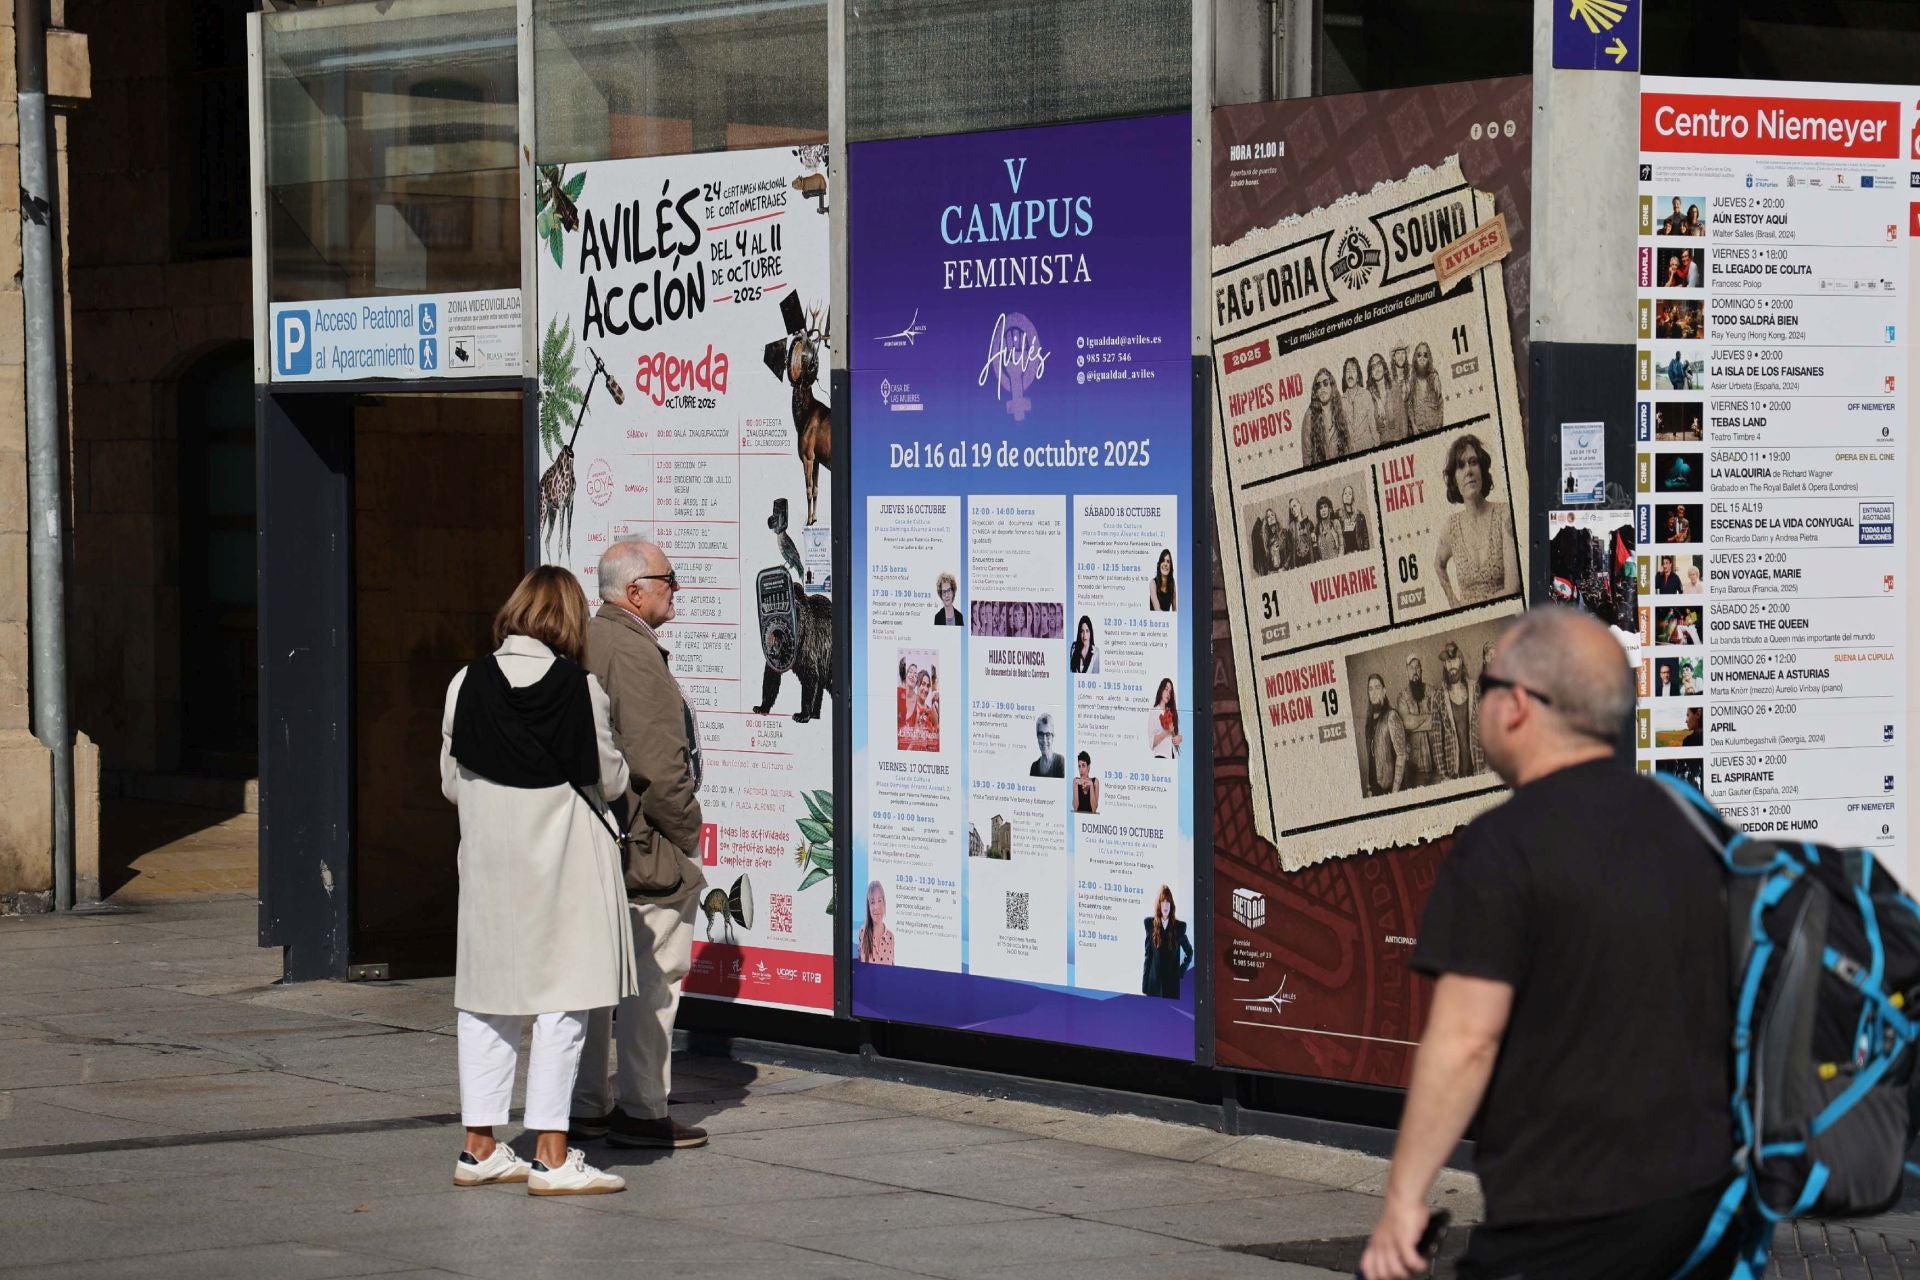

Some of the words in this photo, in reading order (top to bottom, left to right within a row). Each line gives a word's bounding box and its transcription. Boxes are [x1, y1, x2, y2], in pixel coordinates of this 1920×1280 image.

[1655, 106, 1748, 138] Centro
[1757, 109, 1887, 147] Niemeyer
[1231, 145, 1251, 160] HORA
[1255, 142, 1276, 159] 21.00
[1279, 141, 1284, 156] H
[1004, 158, 1027, 193] V
[704, 181, 721, 201] 24
[723, 184, 756, 198] CERTAMEN
[758, 177, 786, 194] NACIONAL
[706, 206, 715, 219] DE
[719, 191, 787, 217] CORTOMETRAJES
[1713, 197, 1747, 208] JUEVES
[1749, 198, 1754, 208] 2
[1763, 199, 1784, 208] 20:00
[580, 179, 700, 274] AVILÉS
[941, 196, 1093, 244] CAMPUS
[1713, 212, 1732, 224] AÚN
[1734, 214, 1764, 224] ESTOY
[1766, 212, 1788, 225] AQUÍ
[711, 239, 732, 261] DEL
[736, 230, 746, 257] 4
[752, 236, 767, 254] AL
[1445, 230, 1499, 270] AVILÉS
[712, 270, 724, 286] DE
[727, 256, 782, 282] OCTUBRE
[944, 254, 1091, 289] FEMINISTA
[1216, 256, 1318, 326] FACTORIA
[1392, 201, 1466, 263] SOUND
[1712, 265, 1723, 274] EL
[1726, 265, 1762, 274] LEGADO
[1766, 265, 1777, 274] DE
[1780, 265, 1812, 275] COLITA
[583, 254, 705, 340] ACCIÓN
[734, 287, 762, 303] 2025
[448, 299, 467, 313] ZONA
[469, 297, 520, 311] VIDEOVIGILADA
[315, 309, 357, 332] Acceso
[363, 304, 413, 329] Peatonal
[1290, 336, 1298, 346] La
[1300, 328, 1325, 343] música
[1337, 319, 1352, 329] vivo
[1354, 313, 1363, 324] de
[1365, 311, 1371, 320] la
[1373, 299, 1403, 317] Factoría
[1405, 288, 1436, 306] Cultural
[1712, 315, 1737, 325] TODO
[1740, 313, 1775, 325] SALDRÁ
[1777, 316, 1798, 325] BIEN
[285, 318, 305, 369] P
[1452, 325, 1469, 355] 11
[316, 347, 325, 369] al
[332, 343, 414, 373] Aparcamiento
[979, 313, 1050, 400] Avilés
[1086, 354, 1099, 363] 985
[1102, 354, 1116, 363] 527
[1118, 353, 1131, 362] 546
[1232, 349, 1261, 366] 2025
[636, 344, 728, 406] agenda
[1086, 369, 1154, 381] @igualdad_aviles
[1454, 360, 1476, 374] OCT
[1711, 367, 1722, 376] LA
[1725, 367, 1744, 376] ISLA
[1747, 367, 1758, 376] DE
[1762, 367, 1779, 376] LOS
[1782, 367, 1824, 376] FAISANES
[666, 396, 696, 409] OCTUBRE
[698, 398, 716, 408] 2025
[900, 394, 920, 402] MUJERES
[1229, 384, 1274, 417] HIPPIES
[1279, 373, 1303, 400] AND
[1711, 401, 1748, 411] VIERNES
[1751, 401, 1760, 411] 10
[1769, 401, 1791, 411] 20:00
[1233, 409, 1292, 448] COWBOYS
[1711, 418, 1740, 427] TEBAS
[1743, 417, 1766, 426] LAND
[890, 442, 920, 468] Del
[925, 444, 943, 467] 16
[948, 441, 966, 467] al
[972, 443, 991, 467] 19
[997, 441, 1019, 467] de
[1024, 440, 1098, 467] octubre
[1104, 439, 1150, 466] 2025
[1382, 454, 1415, 485] LILLY
[1711, 469, 1721, 478] LA
[1724, 468, 1771, 479] VALQUIRIA
[1385, 480, 1424, 512] HIATT
[880, 505, 904, 514] JUEVES
[906, 505, 914, 514] 16
[915, 505, 946, 514] OCTUBRE
[1085, 505, 1114, 516] SÁBADO
[1117, 508, 1124, 516] 18
[1127, 507, 1160, 517] OCTUBRE
[1711, 503, 1728, 512] DEL
[1731, 503, 1740, 512] 15
[1711, 519, 1752, 529] ESCENAS
[1755, 519, 1767, 528] DE
[1770, 519, 1780, 528] LA
[1783, 518, 1803, 528] VIDA
[1806, 518, 1853, 528] CONYUGAL
[1399, 554, 1418, 583] 06
[1711, 570, 1726, 580] BON
[1729, 570, 1771, 580] VOYAGE,
[1774, 569, 1801, 579] MARIE
[1310, 566, 1377, 604] VULVARINE
[1262, 590, 1279, 619] 31
[1400, 591, 1423, 606] NOV
[1711, 620, 1730, 630] GOD
[1732, 620, 1756, 630] SAVE
[1759, 620, 1775, 629] THE
[1778, 619, 1808, 629] QUEEN
[1265, 626, 1287, 640] OCT
[989, 650, 1006, 664] HIJAS
[1008, 651, 1016, 664] DE
[1017, 651, 1045, 666] CYNISCA
[1265, 660, 1336, 699] MOONSHINE
[1711, 672, 1723, 681] UN
[1726, 671, 1775, 681] HOMENAJE
[1778, 670, 1784, 679] A
[1787, 669, 1829, 679] ASTURIAS
[1269, 698, 1313, 727] WAGON
[1322, 689, 1338, 717] 19
[1323, 726, 1341, 739] DIC
[1711, 722, 1736, 732] APRIL
[879, 762, 907, 772] VIERNES
[910, 764, 918, 772] 17
[919, 764, 949, 774] OCTUBRE
[1711, 774, 1722, 783] EL
[1725, 772, 1774, 782] ASPIRANTE
[1751, 807, 1759, 816] 31
[1769, 805, 1791, 815] 20:00
[1082, 824, 1117, 837] DOMINGO
[1120, 825, 1127, 837] 19
[1129, 825, 1163, 839] OCTUBRE
[1777, 822, 1789, 830] DE
[1791, 820, 1818, 829] HUMO
[720, 826, 737, 838] todas
[740, 826, 749, 838] las
[751, 829, 789, 842] actividades
[720, 855, 753, 868] completar
